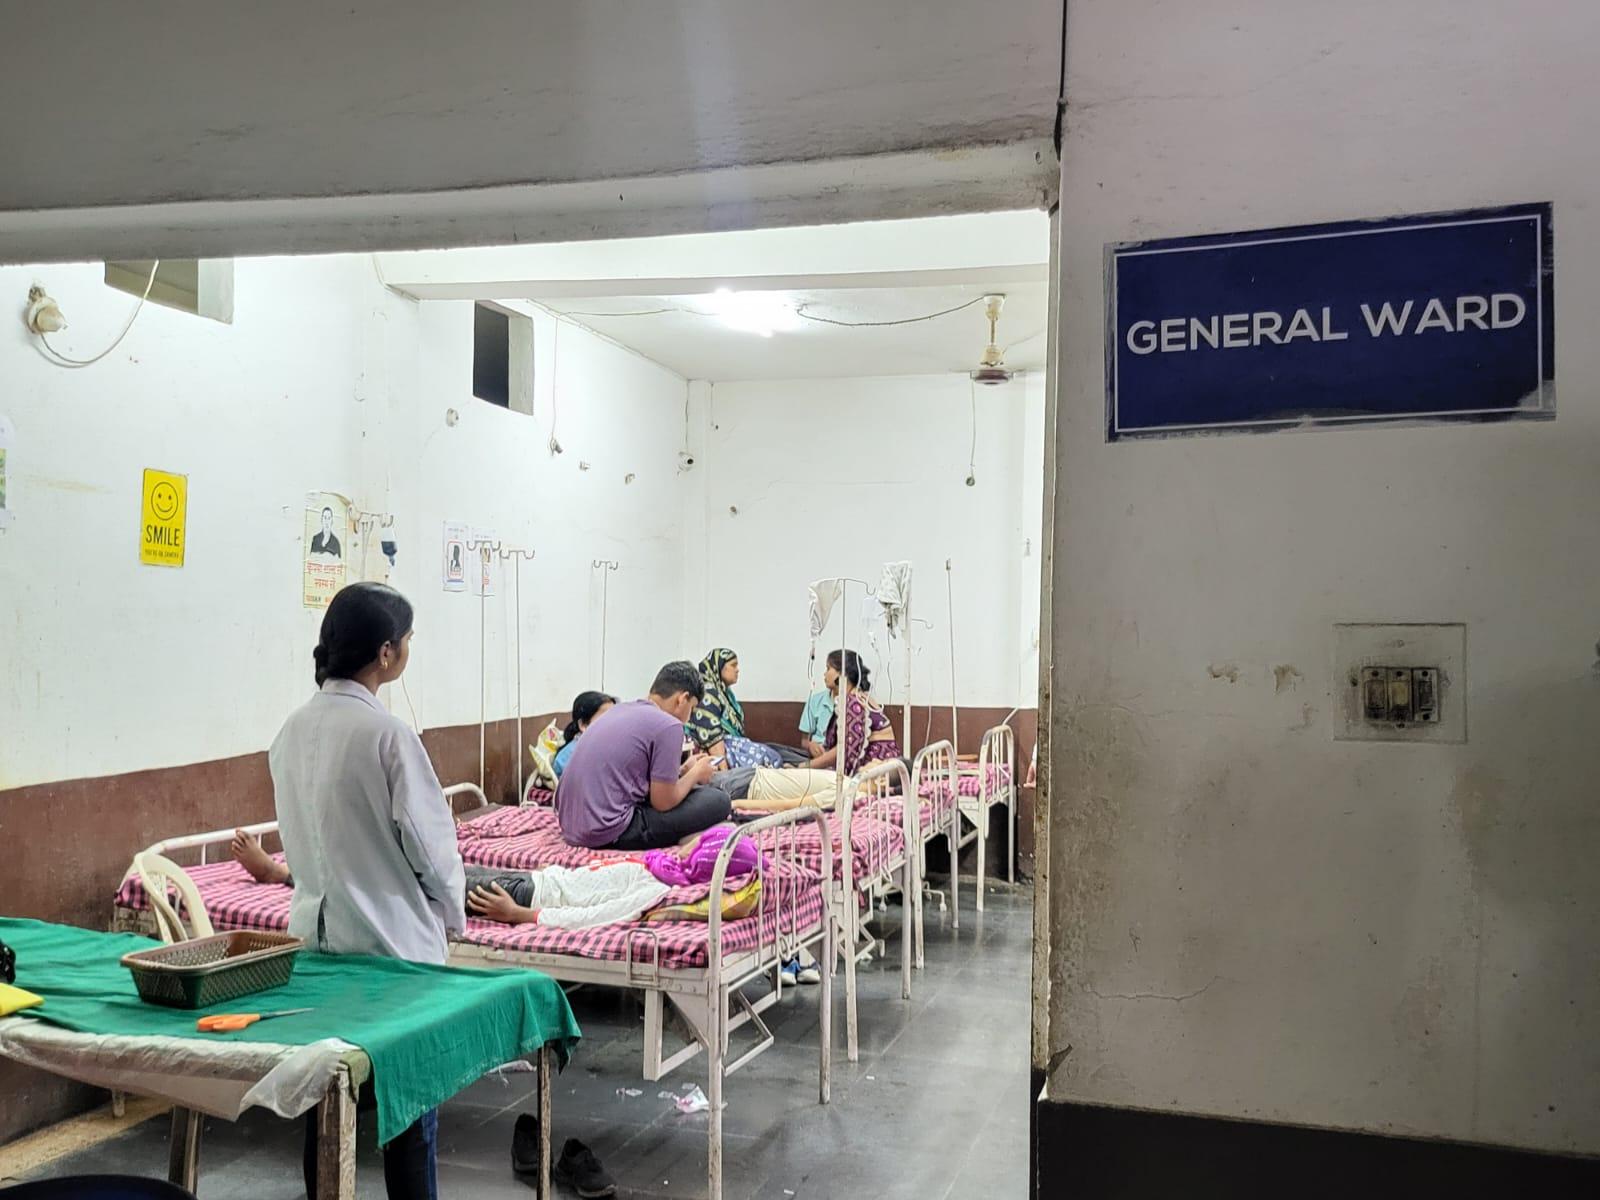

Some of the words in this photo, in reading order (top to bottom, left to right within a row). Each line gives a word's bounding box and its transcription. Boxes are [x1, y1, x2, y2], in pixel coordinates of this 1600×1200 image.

[1126, 306, 1349, 355] GENERAL
[1360, 293, 1527, 337] WARD
[145, 523, 180, 547] SMILE
